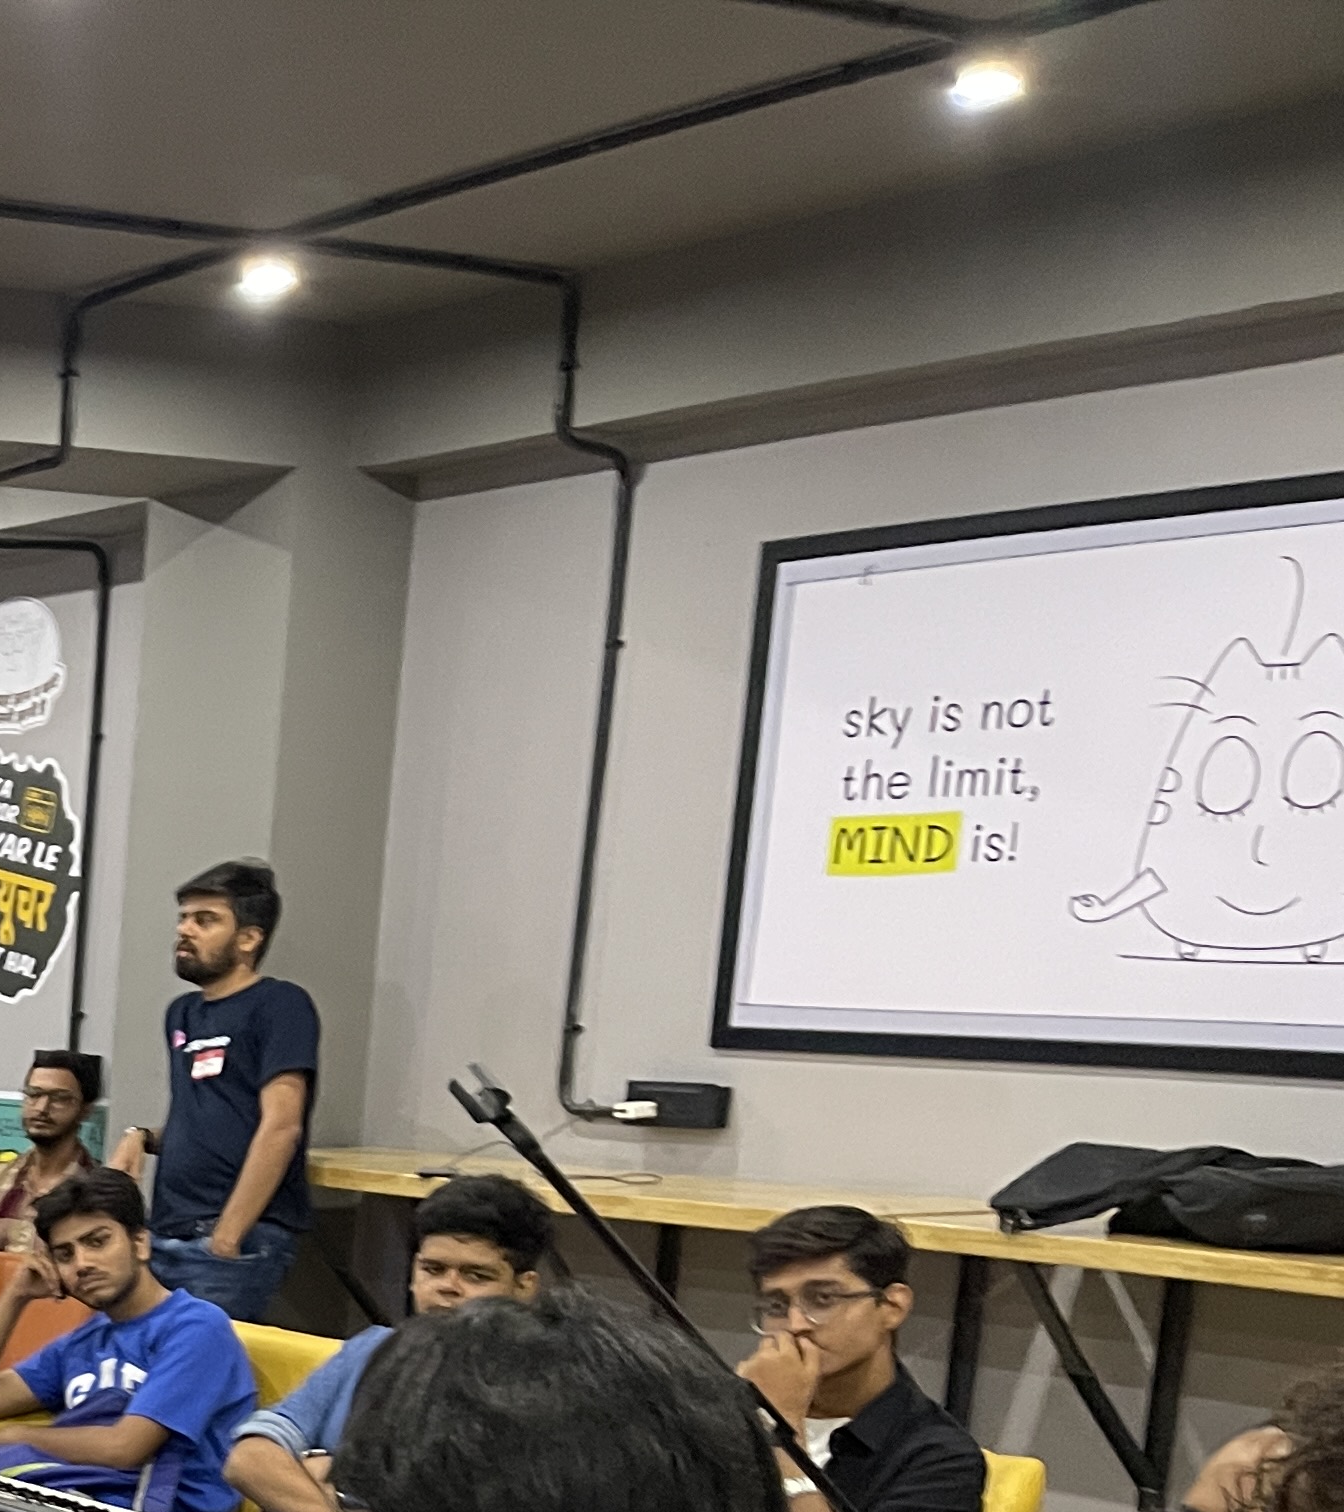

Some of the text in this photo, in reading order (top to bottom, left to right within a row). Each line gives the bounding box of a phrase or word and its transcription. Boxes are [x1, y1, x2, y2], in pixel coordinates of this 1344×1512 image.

[842, 688, 1054, 749] sky is not
[842, 754, 1040, 801] the limit,
[32, 841, 63, 872] LE
[832, 821, 1020, 865] MIND is!
